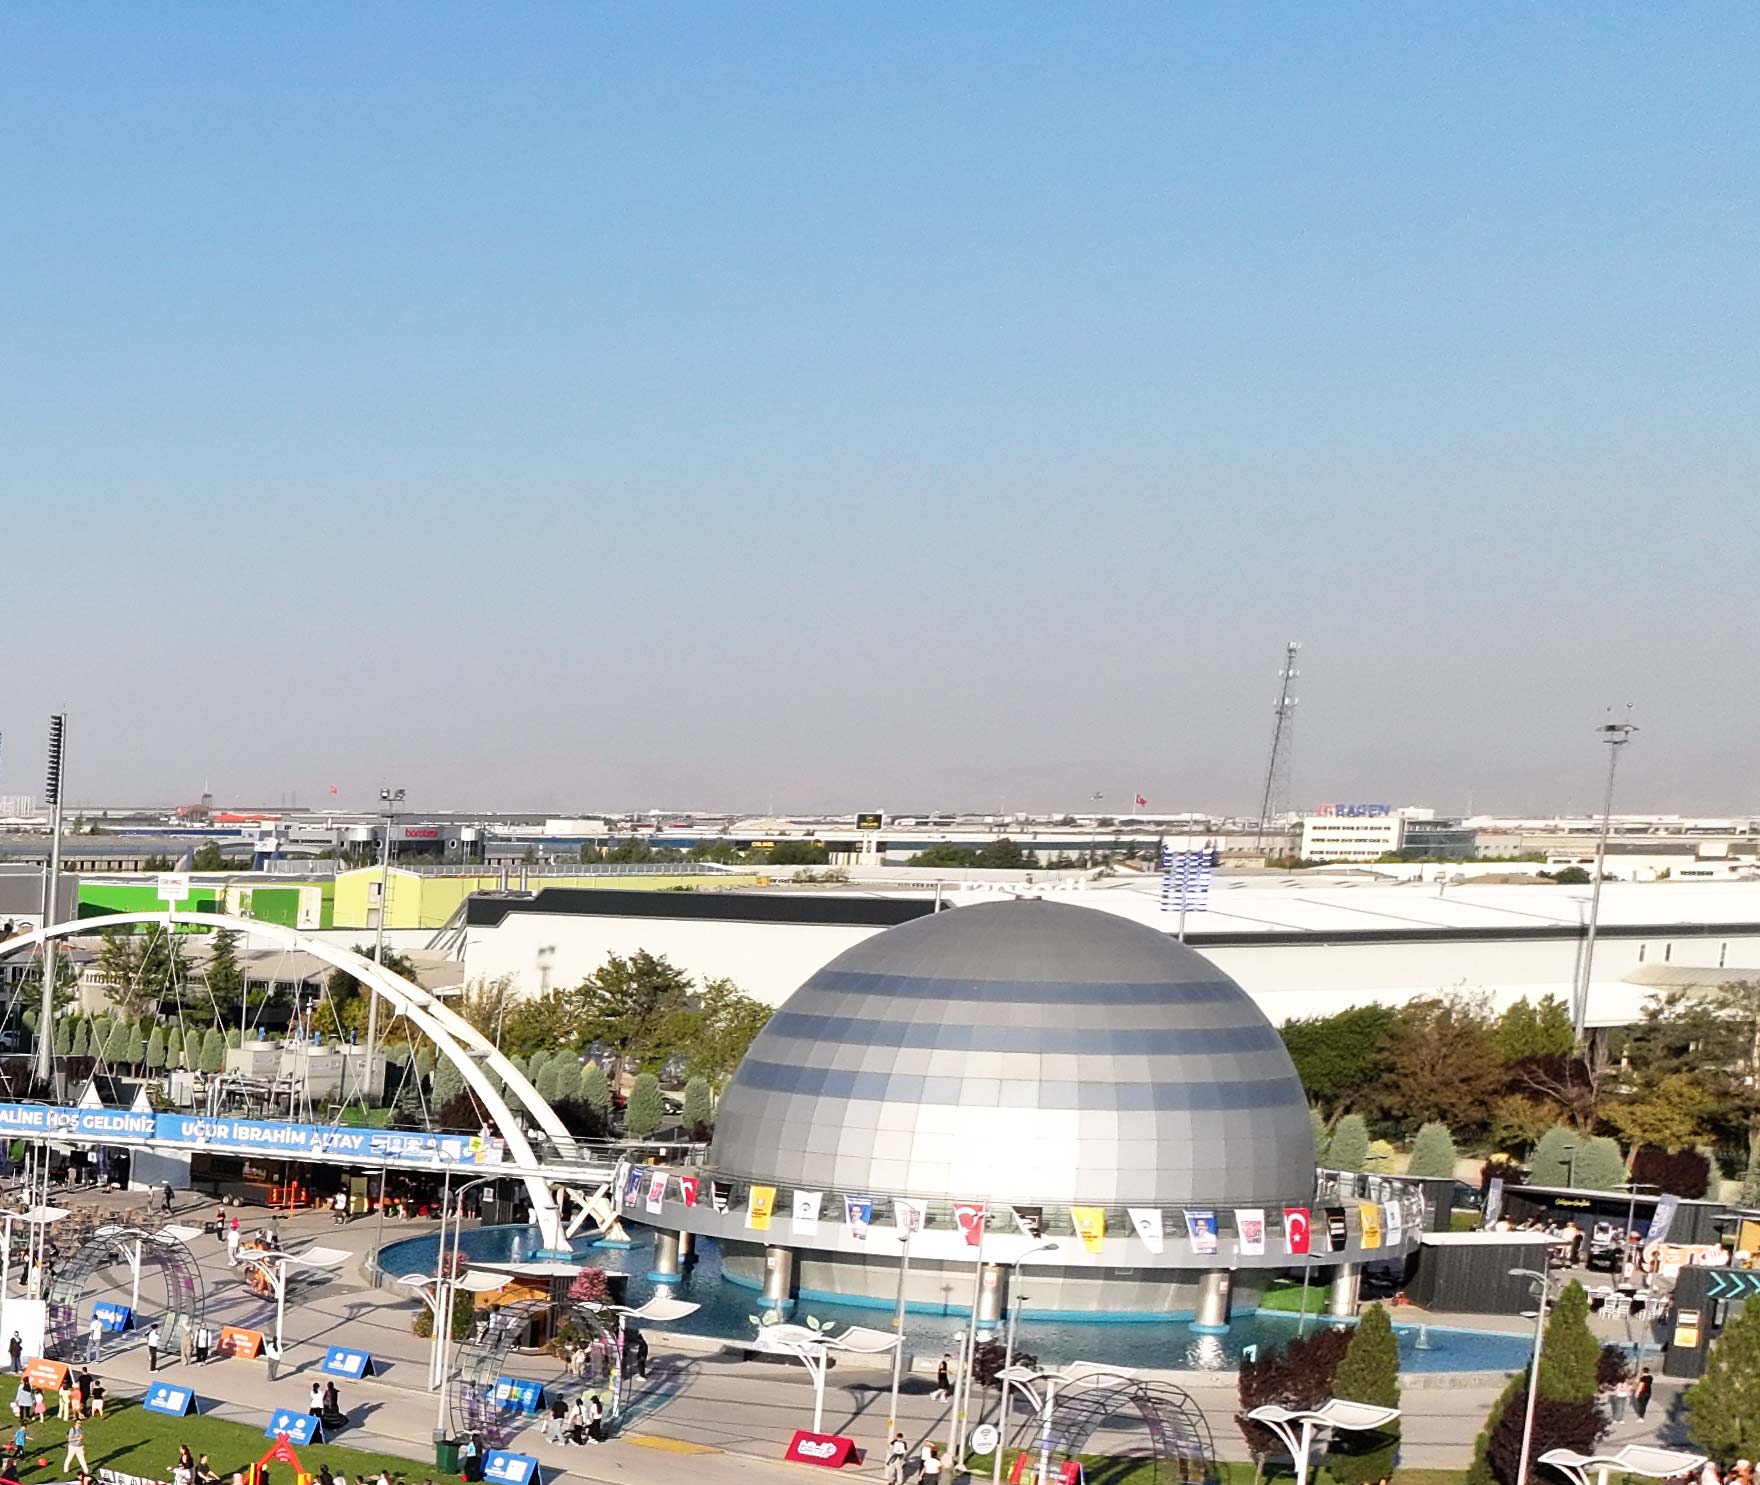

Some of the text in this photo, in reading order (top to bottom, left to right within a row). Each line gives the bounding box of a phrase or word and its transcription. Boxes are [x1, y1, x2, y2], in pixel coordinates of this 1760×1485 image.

[82, 1113, 155, 1133] GELDİNİZ
[232, 1122, 306, 1145] İBRAHİM
[310, 1132, 364, 1150] ALTAY
